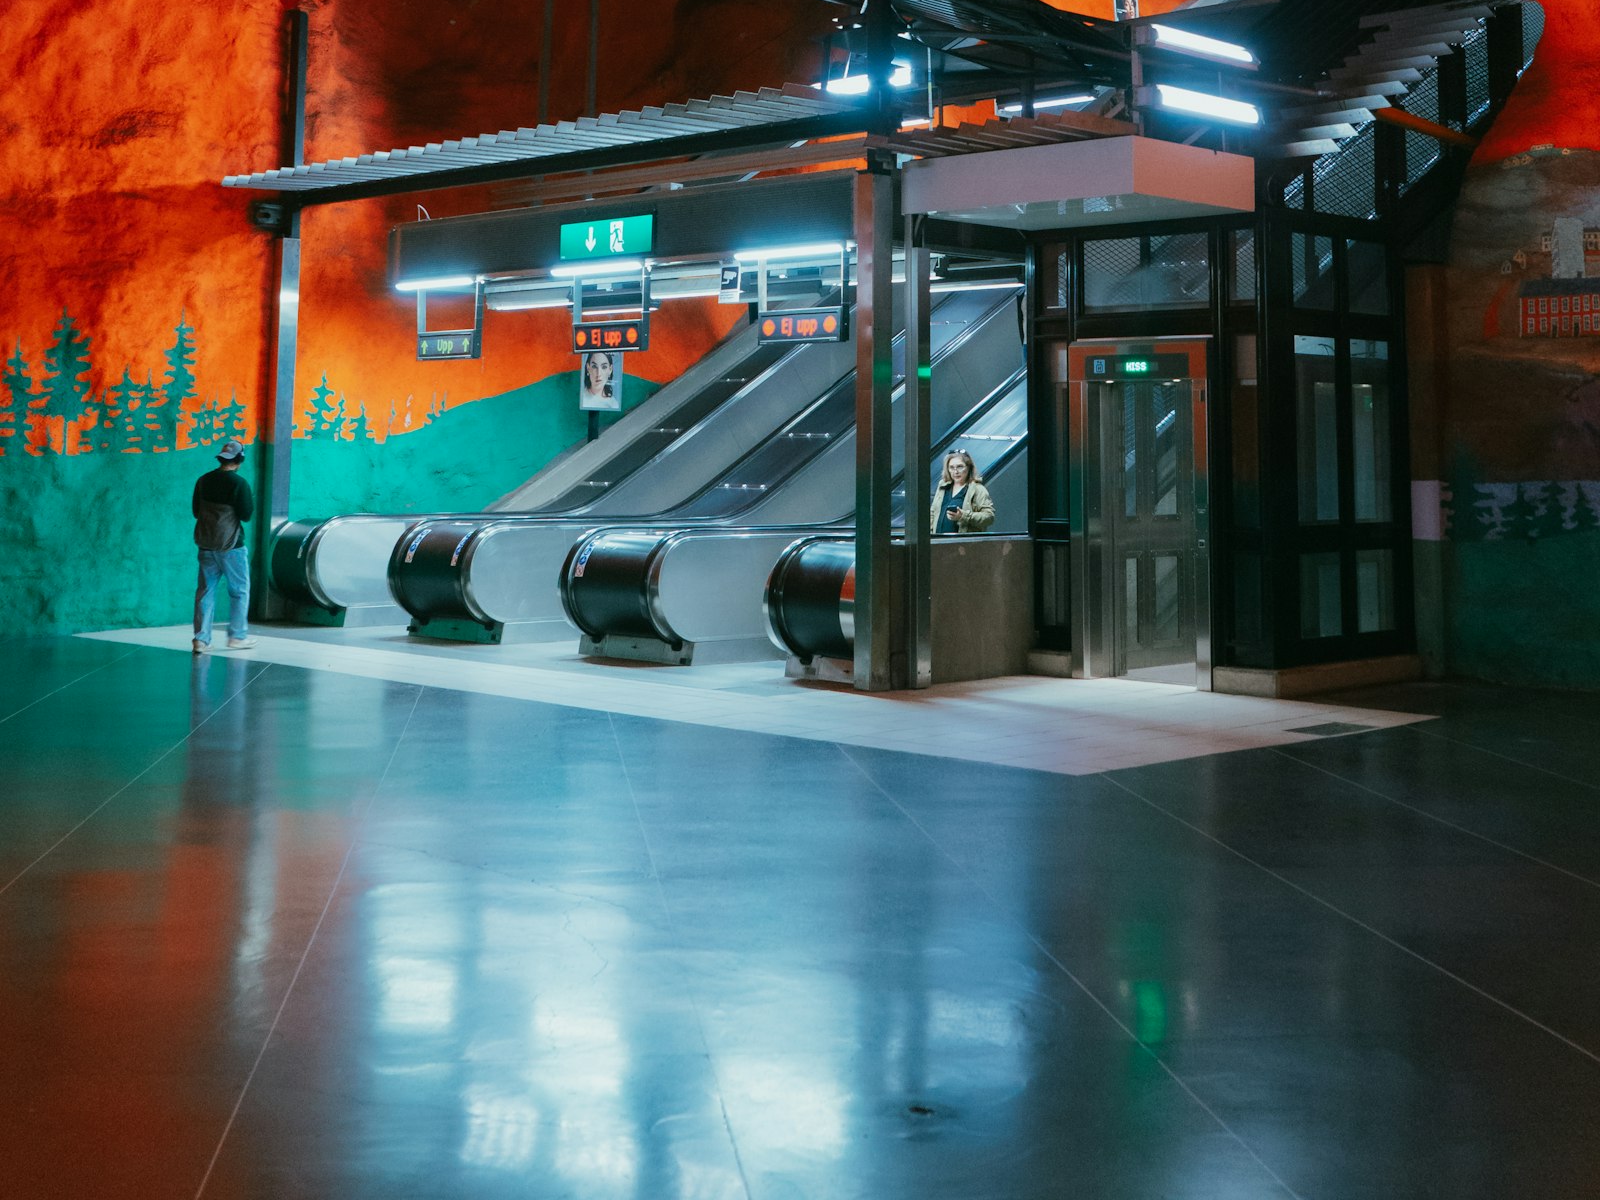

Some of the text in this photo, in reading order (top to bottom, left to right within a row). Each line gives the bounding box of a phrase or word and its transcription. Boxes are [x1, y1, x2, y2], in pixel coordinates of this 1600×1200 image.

[781, 317, 818, 336] Ej upp
[591, 328, 622, 346] Ej upp
[437, 339, 454, 354] Upp
